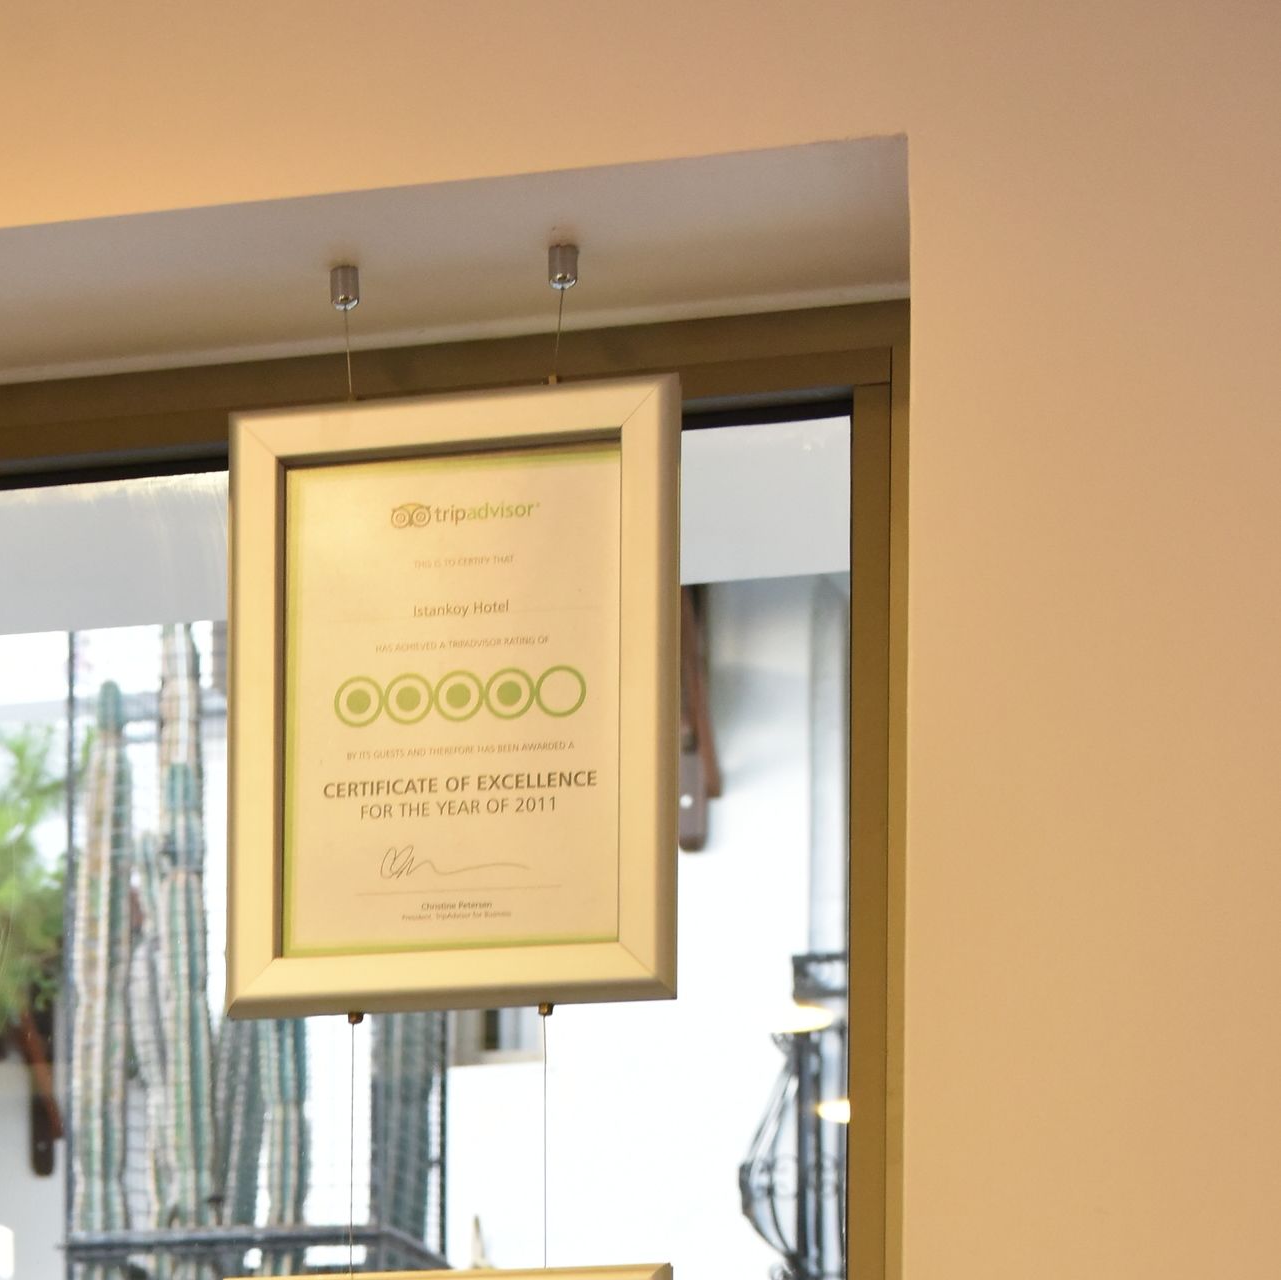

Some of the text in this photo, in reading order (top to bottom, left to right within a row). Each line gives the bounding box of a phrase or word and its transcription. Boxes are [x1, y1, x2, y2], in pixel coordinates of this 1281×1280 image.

[413, 599, 510, 618] Istankoy Hotel
[323, 770, 597, 799] CERTIFICATE OF EXCELLENCE
[360, 795, 557, 820] FOR THE YEAR OF 2011
